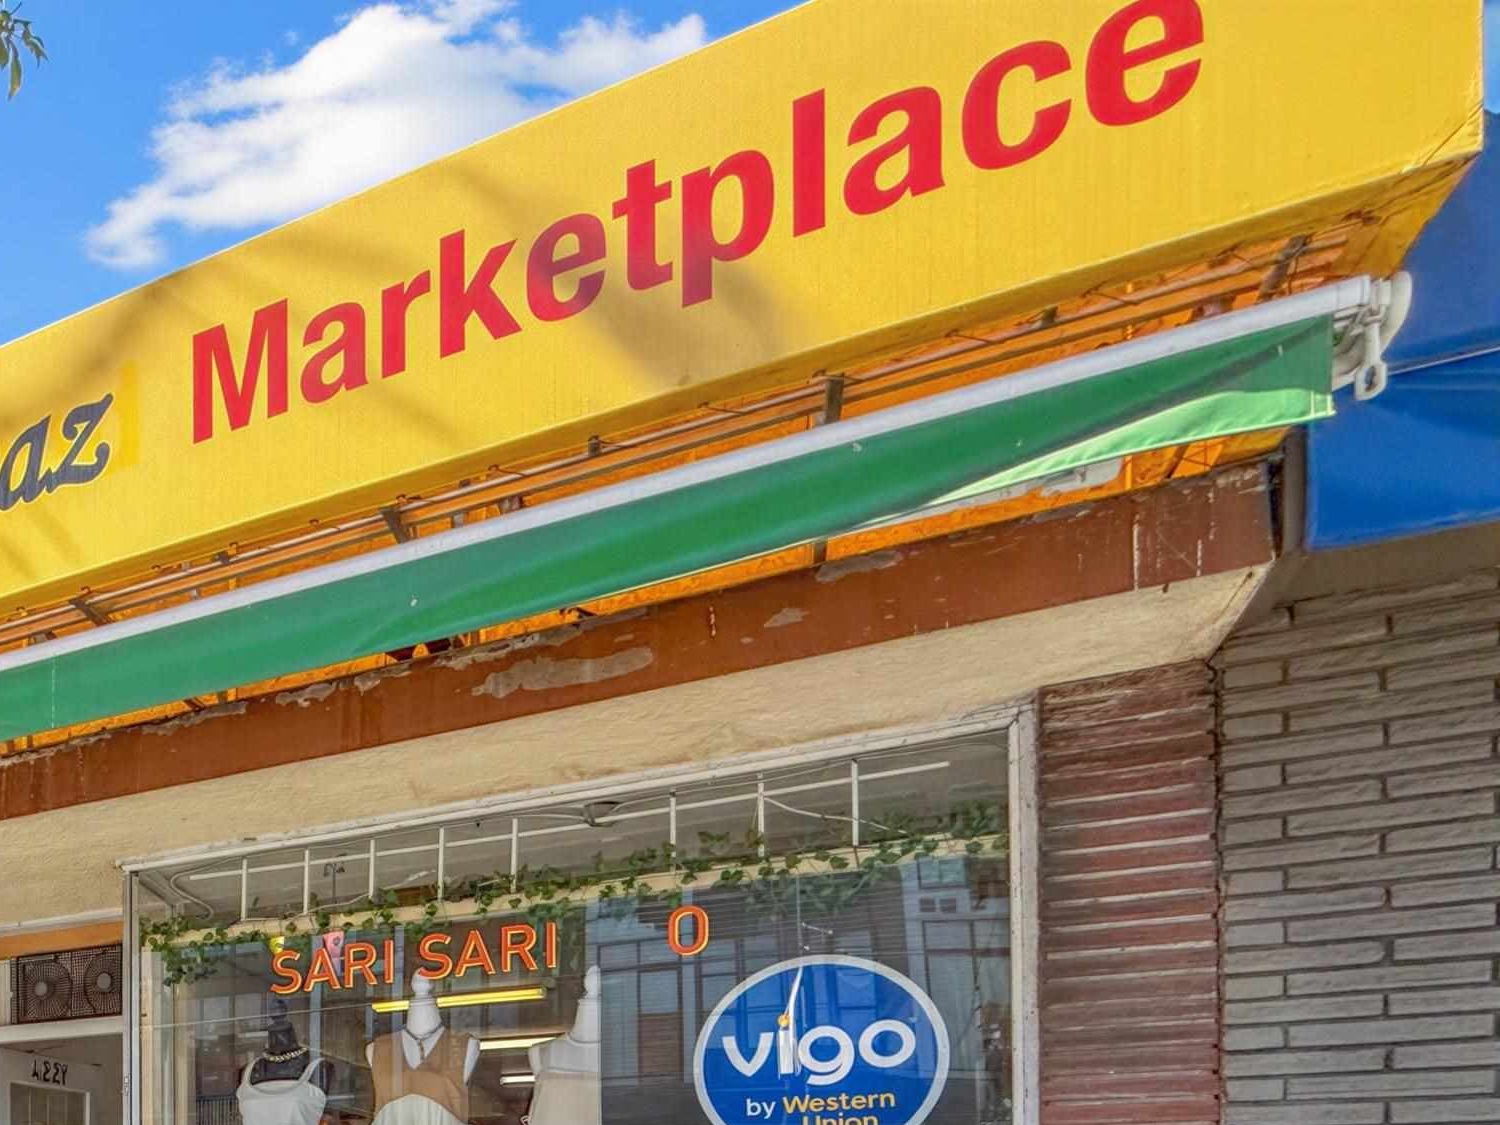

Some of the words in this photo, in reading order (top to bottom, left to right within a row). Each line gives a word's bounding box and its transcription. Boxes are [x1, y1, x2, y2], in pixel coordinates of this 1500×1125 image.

[191, 0, 1205, 445] Marketplace
[270, 939, 395, 995] SARI
[417, 922, 558, 981] SARI
[722, 1012, 917, 1086] vigo
[746, 1098, 776, 1119] by
[782, 1090, 896, 1115] Western
